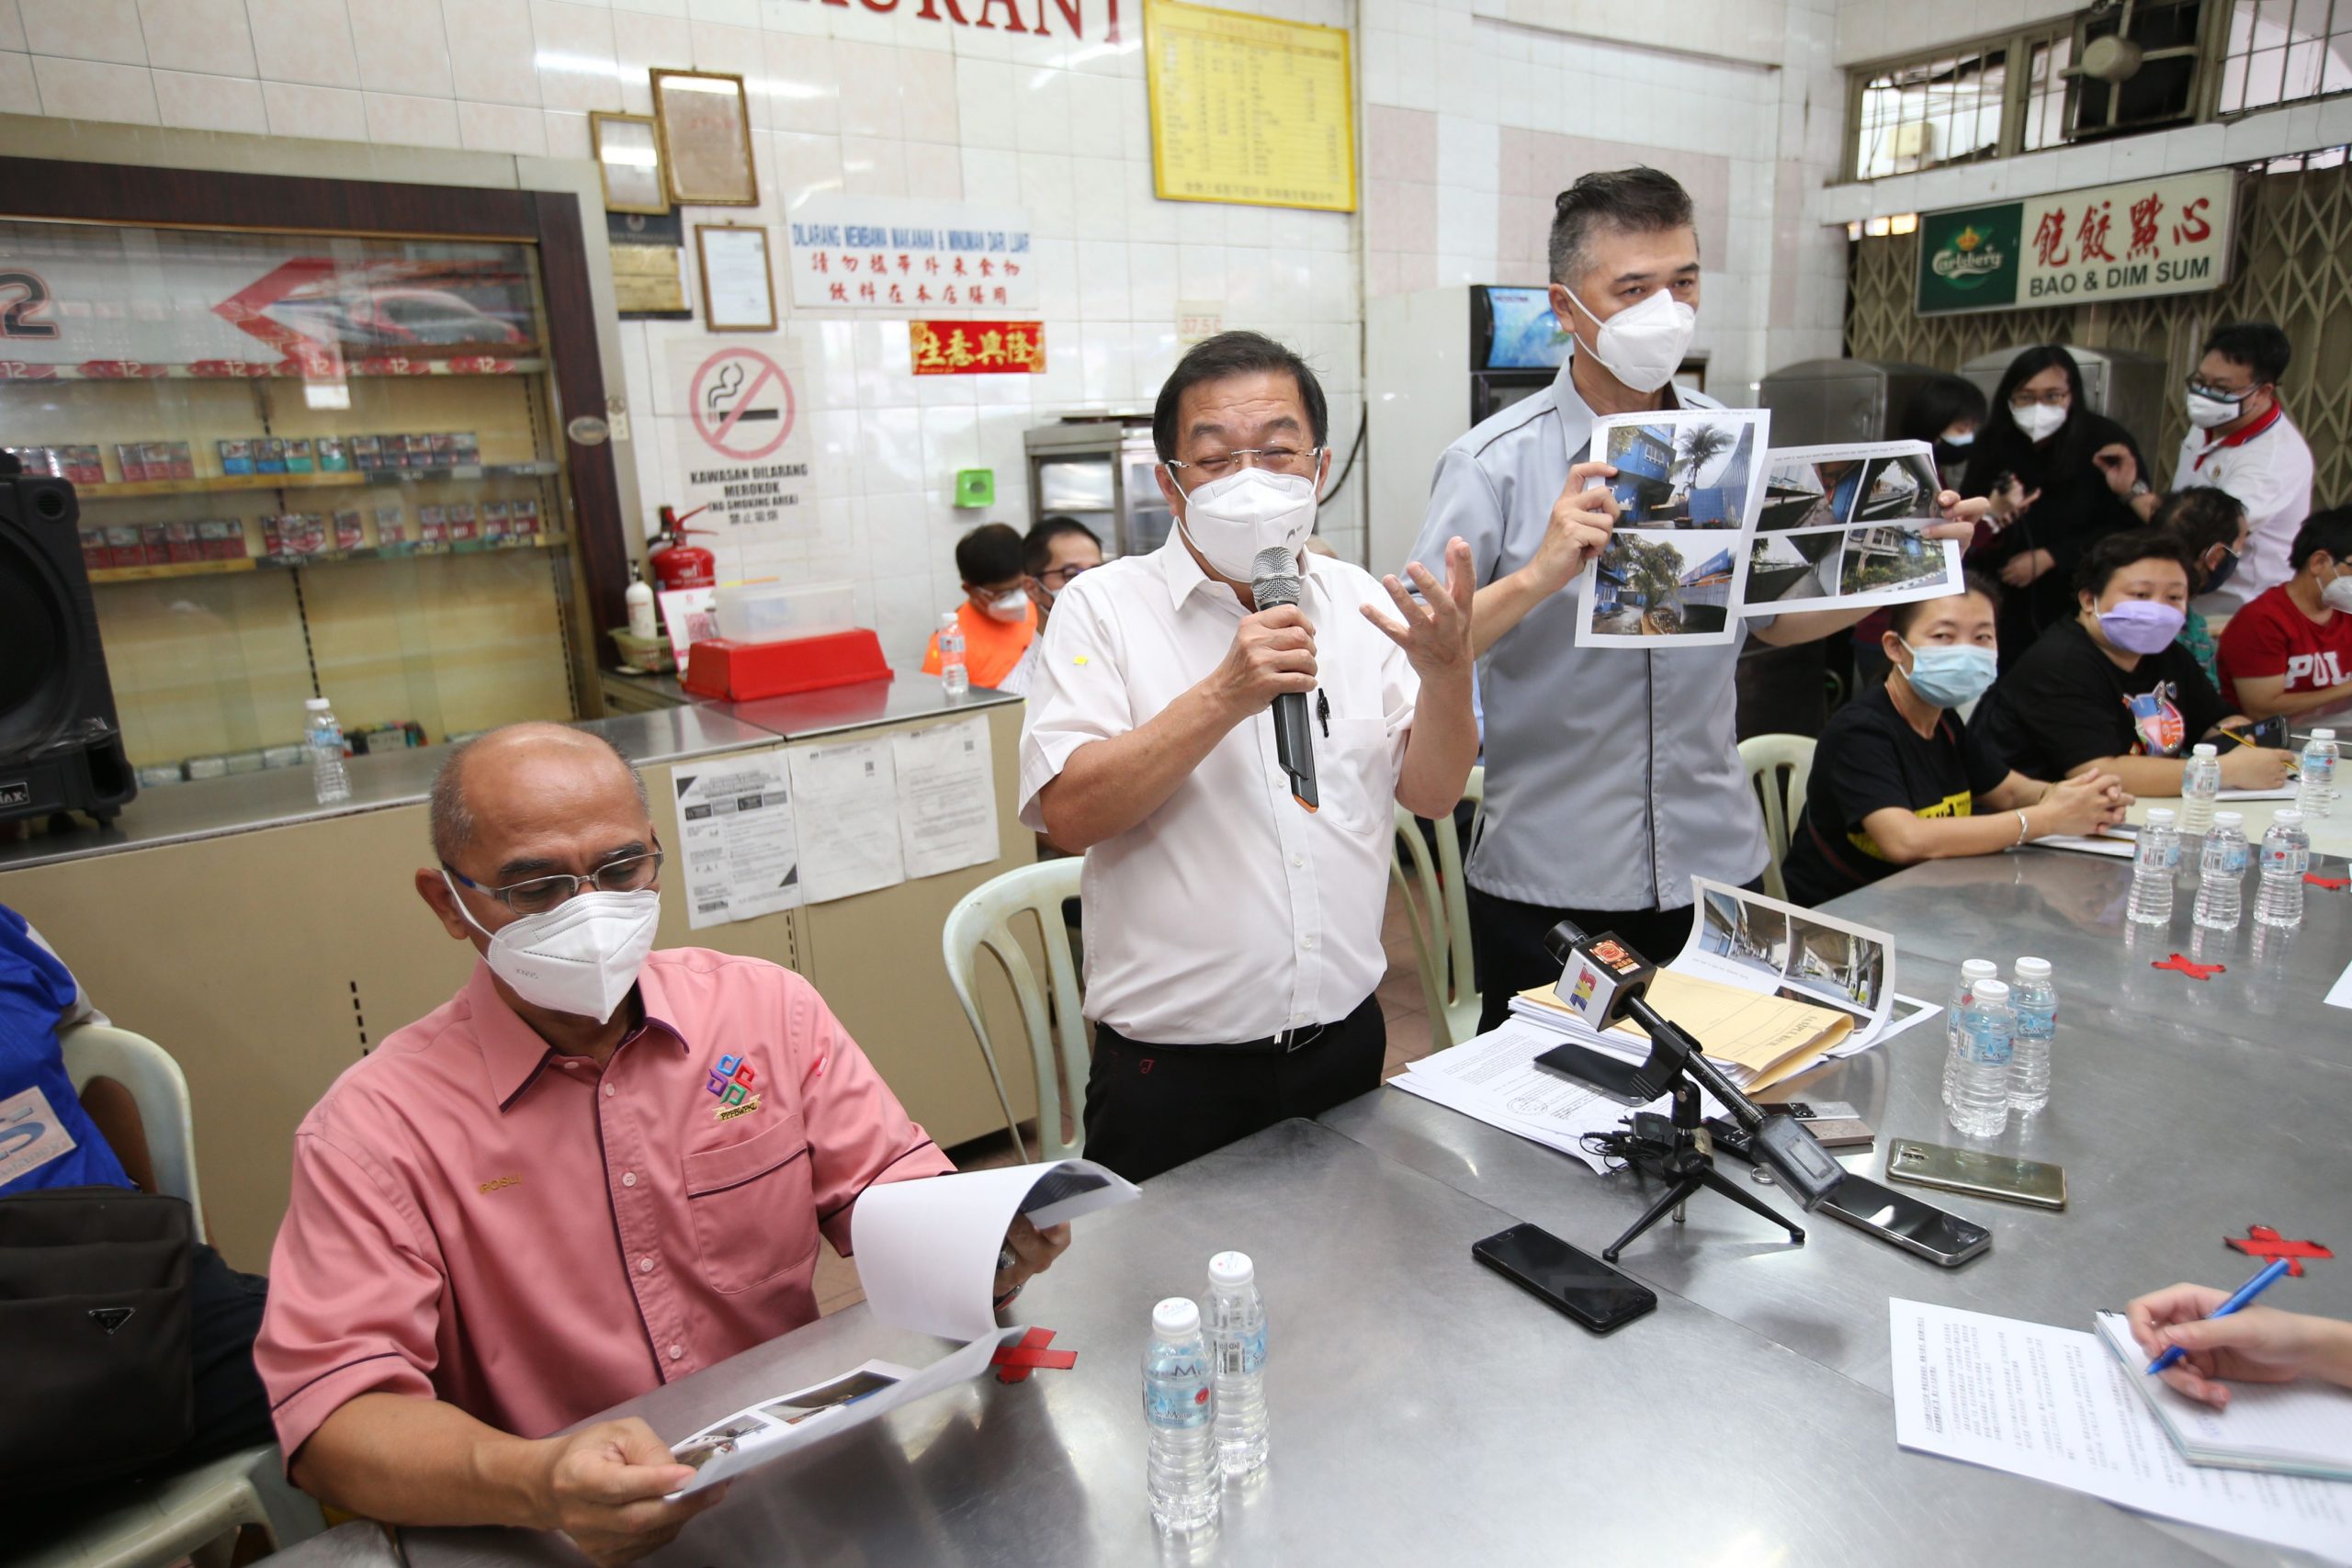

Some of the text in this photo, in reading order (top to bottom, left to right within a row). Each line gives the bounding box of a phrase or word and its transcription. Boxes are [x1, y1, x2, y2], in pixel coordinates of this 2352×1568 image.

[793, 224, 841, 246] DILARANG
[844, 226, 888, 247] MEMBAWA
[892, 228, 935, 249] MAKANAN
[1932, 245, 2003, 277] Carlsberg
[2030, 257, 2211, 297] BAO & DIM SUM
[919, 328, 1034, 367] 生意興隆
[691, 463, 808, 484] KAWASAN DILARANG
[724, 481, 780, 498] MEROKOK
[728, 497, 770, 510] SMOKING
